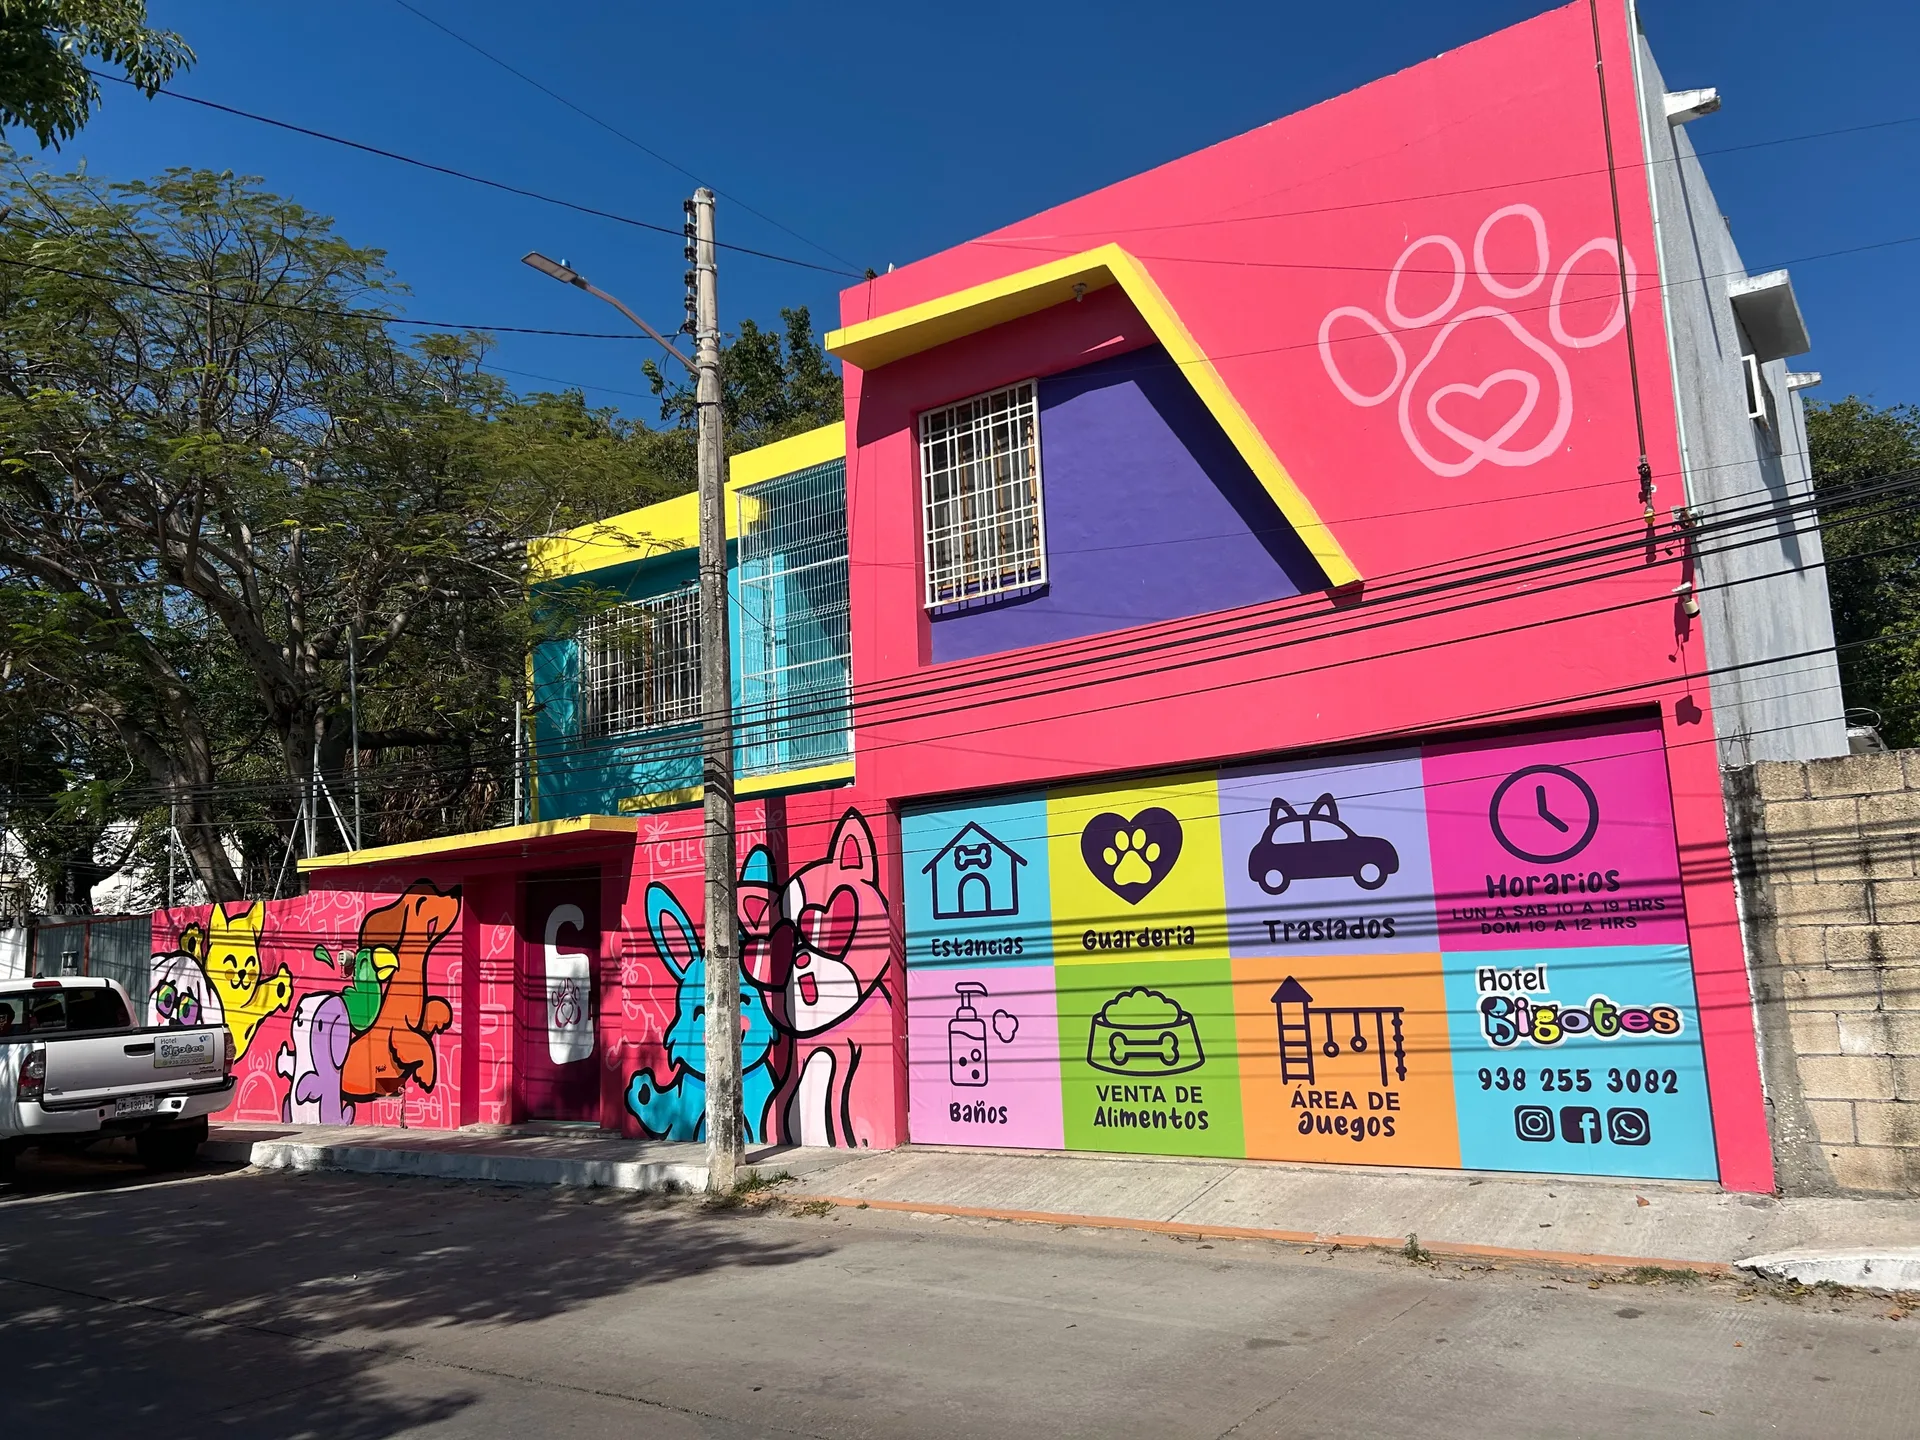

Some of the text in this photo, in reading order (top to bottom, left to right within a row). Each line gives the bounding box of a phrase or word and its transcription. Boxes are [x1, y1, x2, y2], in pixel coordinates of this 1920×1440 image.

[1486, 870, 1621, 899] Horarios
[1452, 898, 1666, 920] LUN A SAB 10 A 19 HRS
[1082, 925, 1196, 951] Guarderia
[1263, 917, 1396, 943] Traslados
[1480, 916, 1637, 935] DOM 10 A 12 HRS
[931, 936, 1024, 958] Estancias
[1479, 966, 1546, 992] Hotel
[1480, 996, 1681, 1047] Bigotes
[1477, 1067, 1679, 1094] 938 255 3082
[1096, 1085, 1204, 1104] VENTA DE
[1290, 1084, 1401, 1110] ÁREA DE
[949, 1099, 1008, 1125] Baños
[1093, 1106, 1209, 1130] Alimentos
[1298, 1111, 1396, 1142] Juegos
